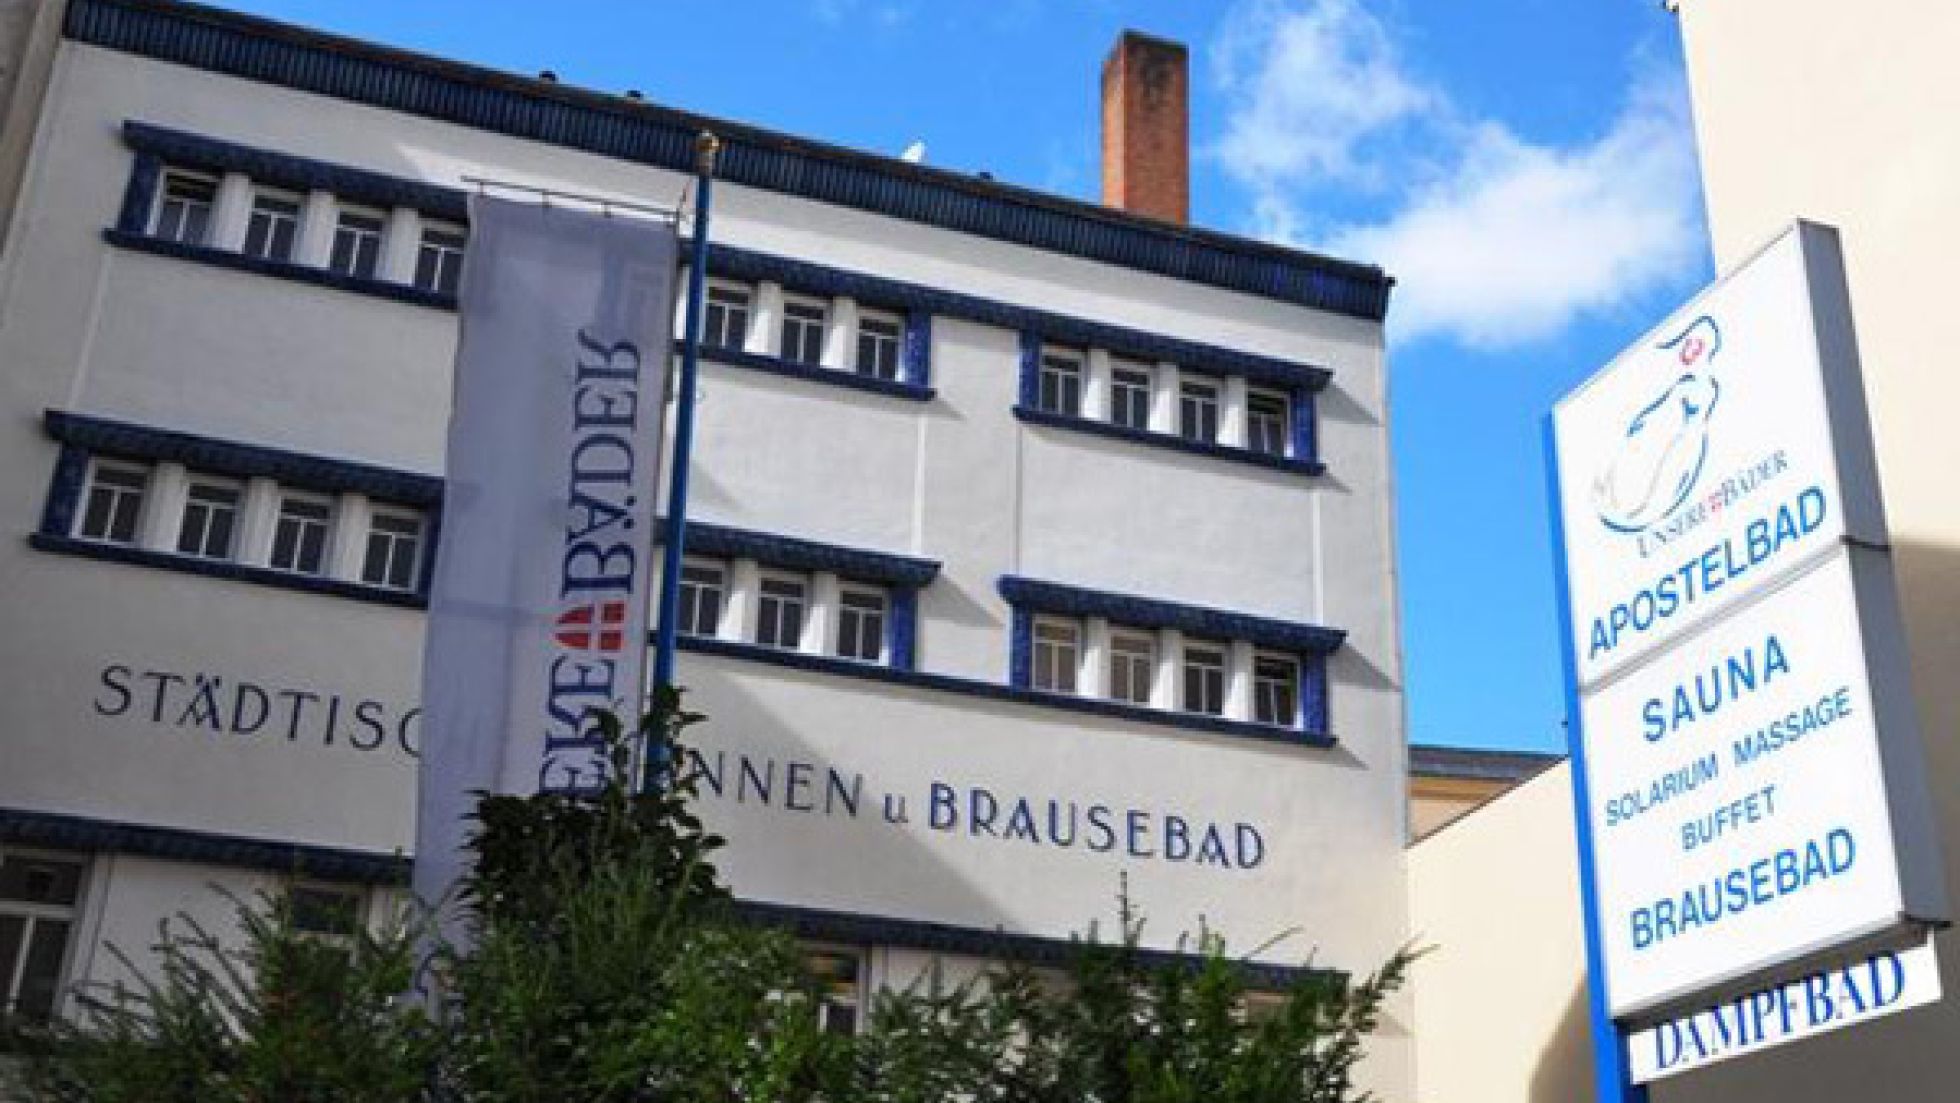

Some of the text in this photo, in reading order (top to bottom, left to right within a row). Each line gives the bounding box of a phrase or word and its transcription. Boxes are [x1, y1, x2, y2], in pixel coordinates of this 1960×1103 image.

[1588, 486, 1827, 660] APOSTELBAD
[1641, 635, 1791, 743] SAUNA
[687, 747, 864, 818] NNEN
[928, 781, 1265, 870] BRAUSEBAD
[1605, 686, 1853, 827] SOLARIUM MASSAGE
[1681, 785, 1778, 851] BUFFET
[1629, 828, 1857, 950] BRAUSEBAD
[1654, 948, 1907, 1071] DAMPFBAD
